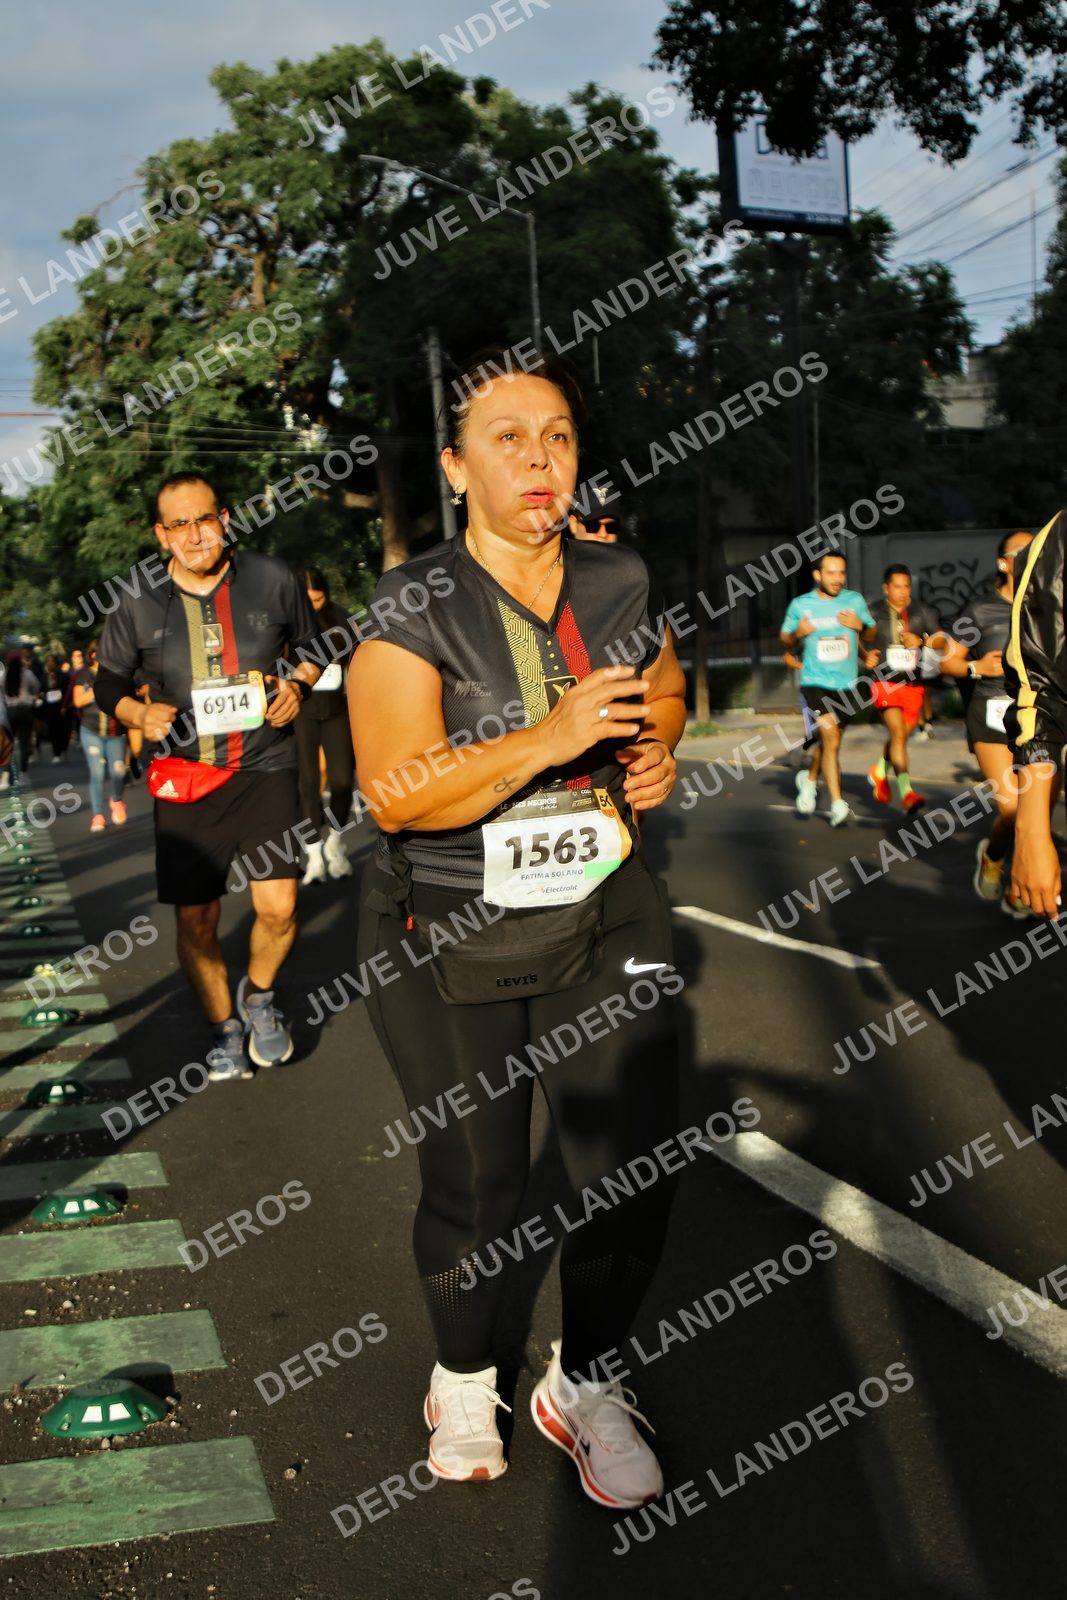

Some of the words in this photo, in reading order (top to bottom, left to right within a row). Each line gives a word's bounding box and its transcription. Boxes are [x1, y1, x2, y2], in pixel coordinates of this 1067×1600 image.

[919, 558, 979, 581] TOY
[204, 692, 250, 714] 6914
[599, 795, 613, 807] 5K
[505, 827, 599, 869] 1563
[521, 872, 549, 880] FATIMA
[551, 869, 583, 877] SOLANO
